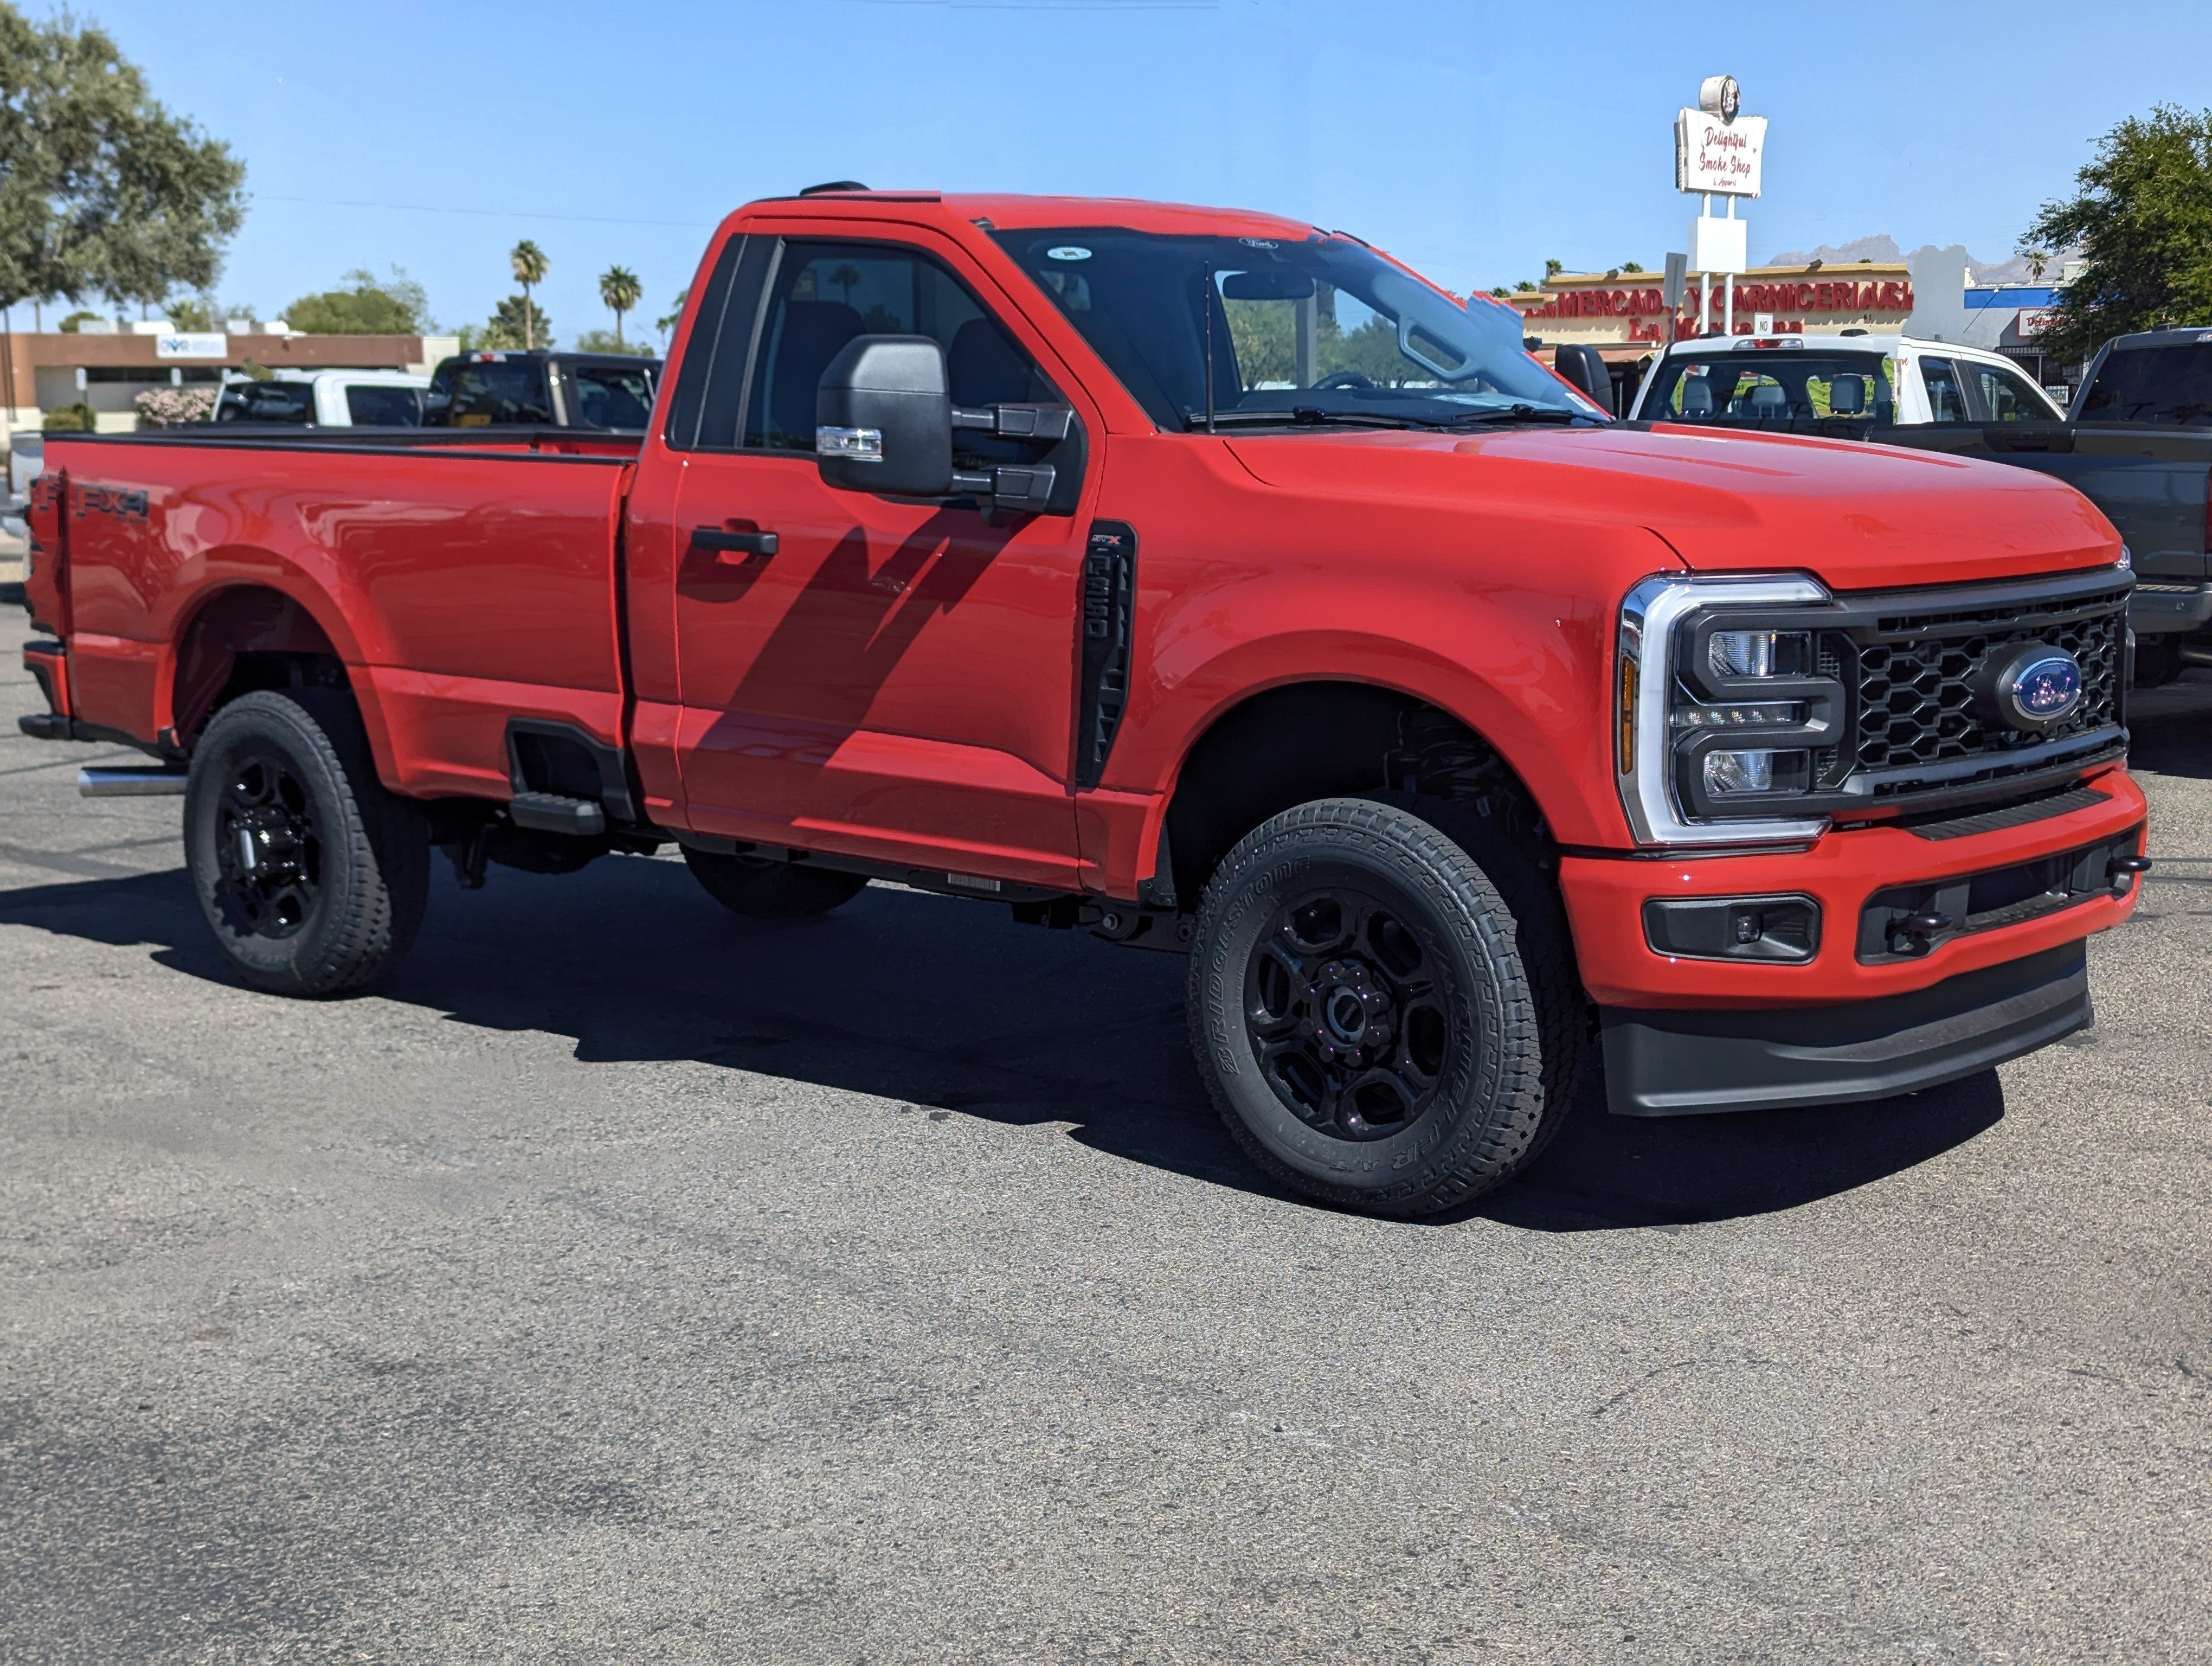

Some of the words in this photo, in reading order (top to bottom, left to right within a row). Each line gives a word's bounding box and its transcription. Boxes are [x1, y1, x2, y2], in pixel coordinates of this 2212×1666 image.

[1705, 126, 1747, 152] Delightful
[1699, 151, 1728, 172] Smoke
[1730, 155, 1751, 179] Shop
[1628, 318, 1663, 342] La
[1759, 320, 1769, 332] NO
[76, 484, 149, 517] FX4
[1091, 534, 1122, 544] STX
[2031, 672, 2071, 707] Ford
[1208, 854, 1311, 1075] BRIDGESTONE
